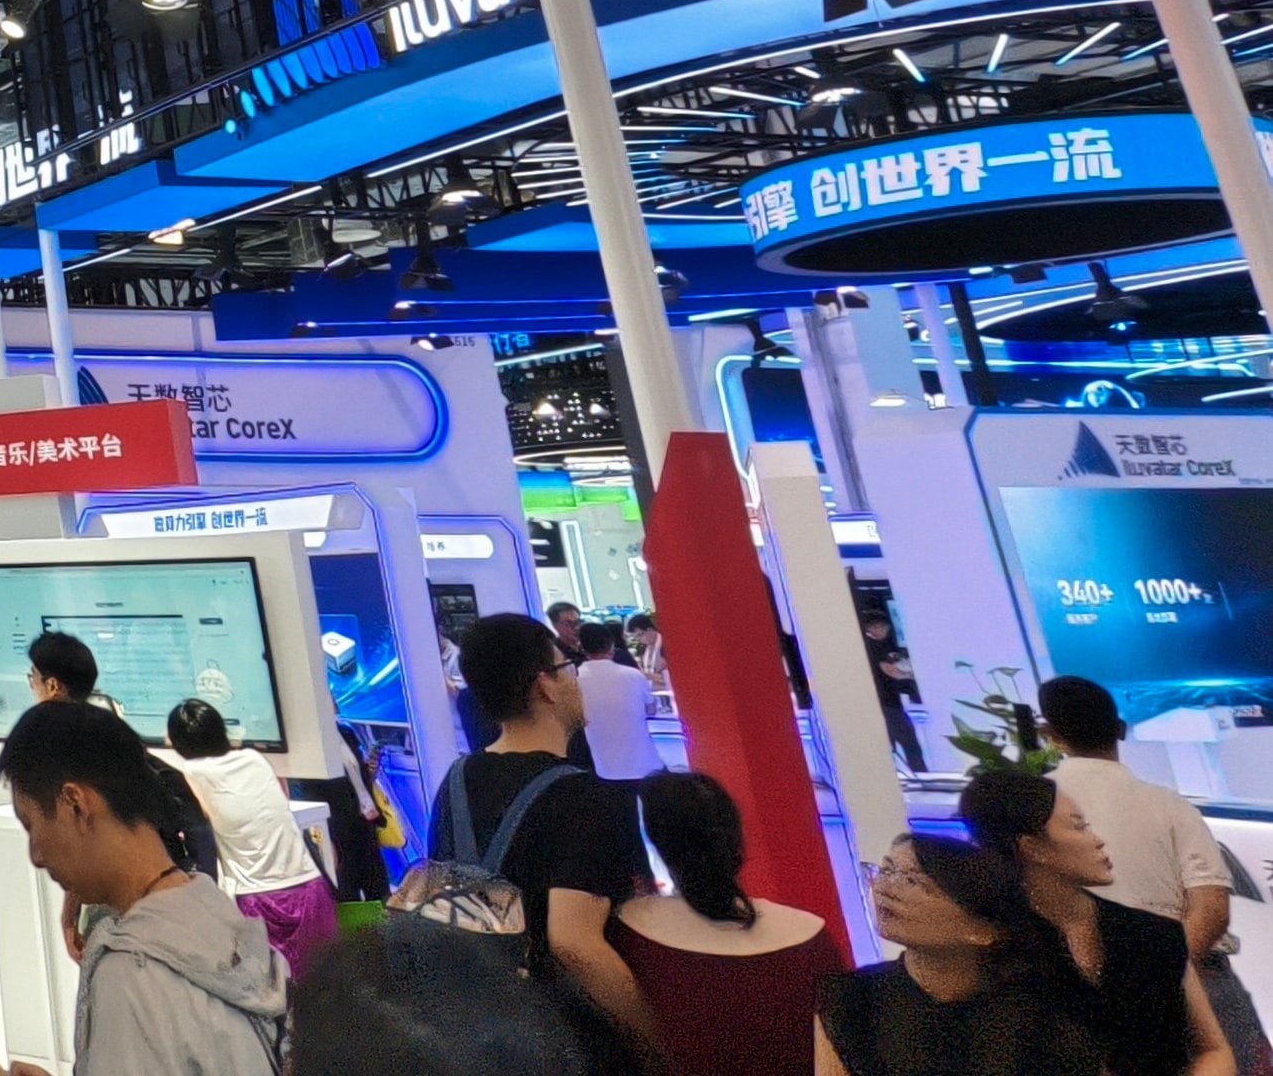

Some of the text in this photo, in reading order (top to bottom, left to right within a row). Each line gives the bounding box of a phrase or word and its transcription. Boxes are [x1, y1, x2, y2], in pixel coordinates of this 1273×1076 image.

[811, 127, 1122, 217] 创世界一流
[226, 417, 296, 439] CoreX
[1057, 578, 1202, 607] 340+ 1000+
